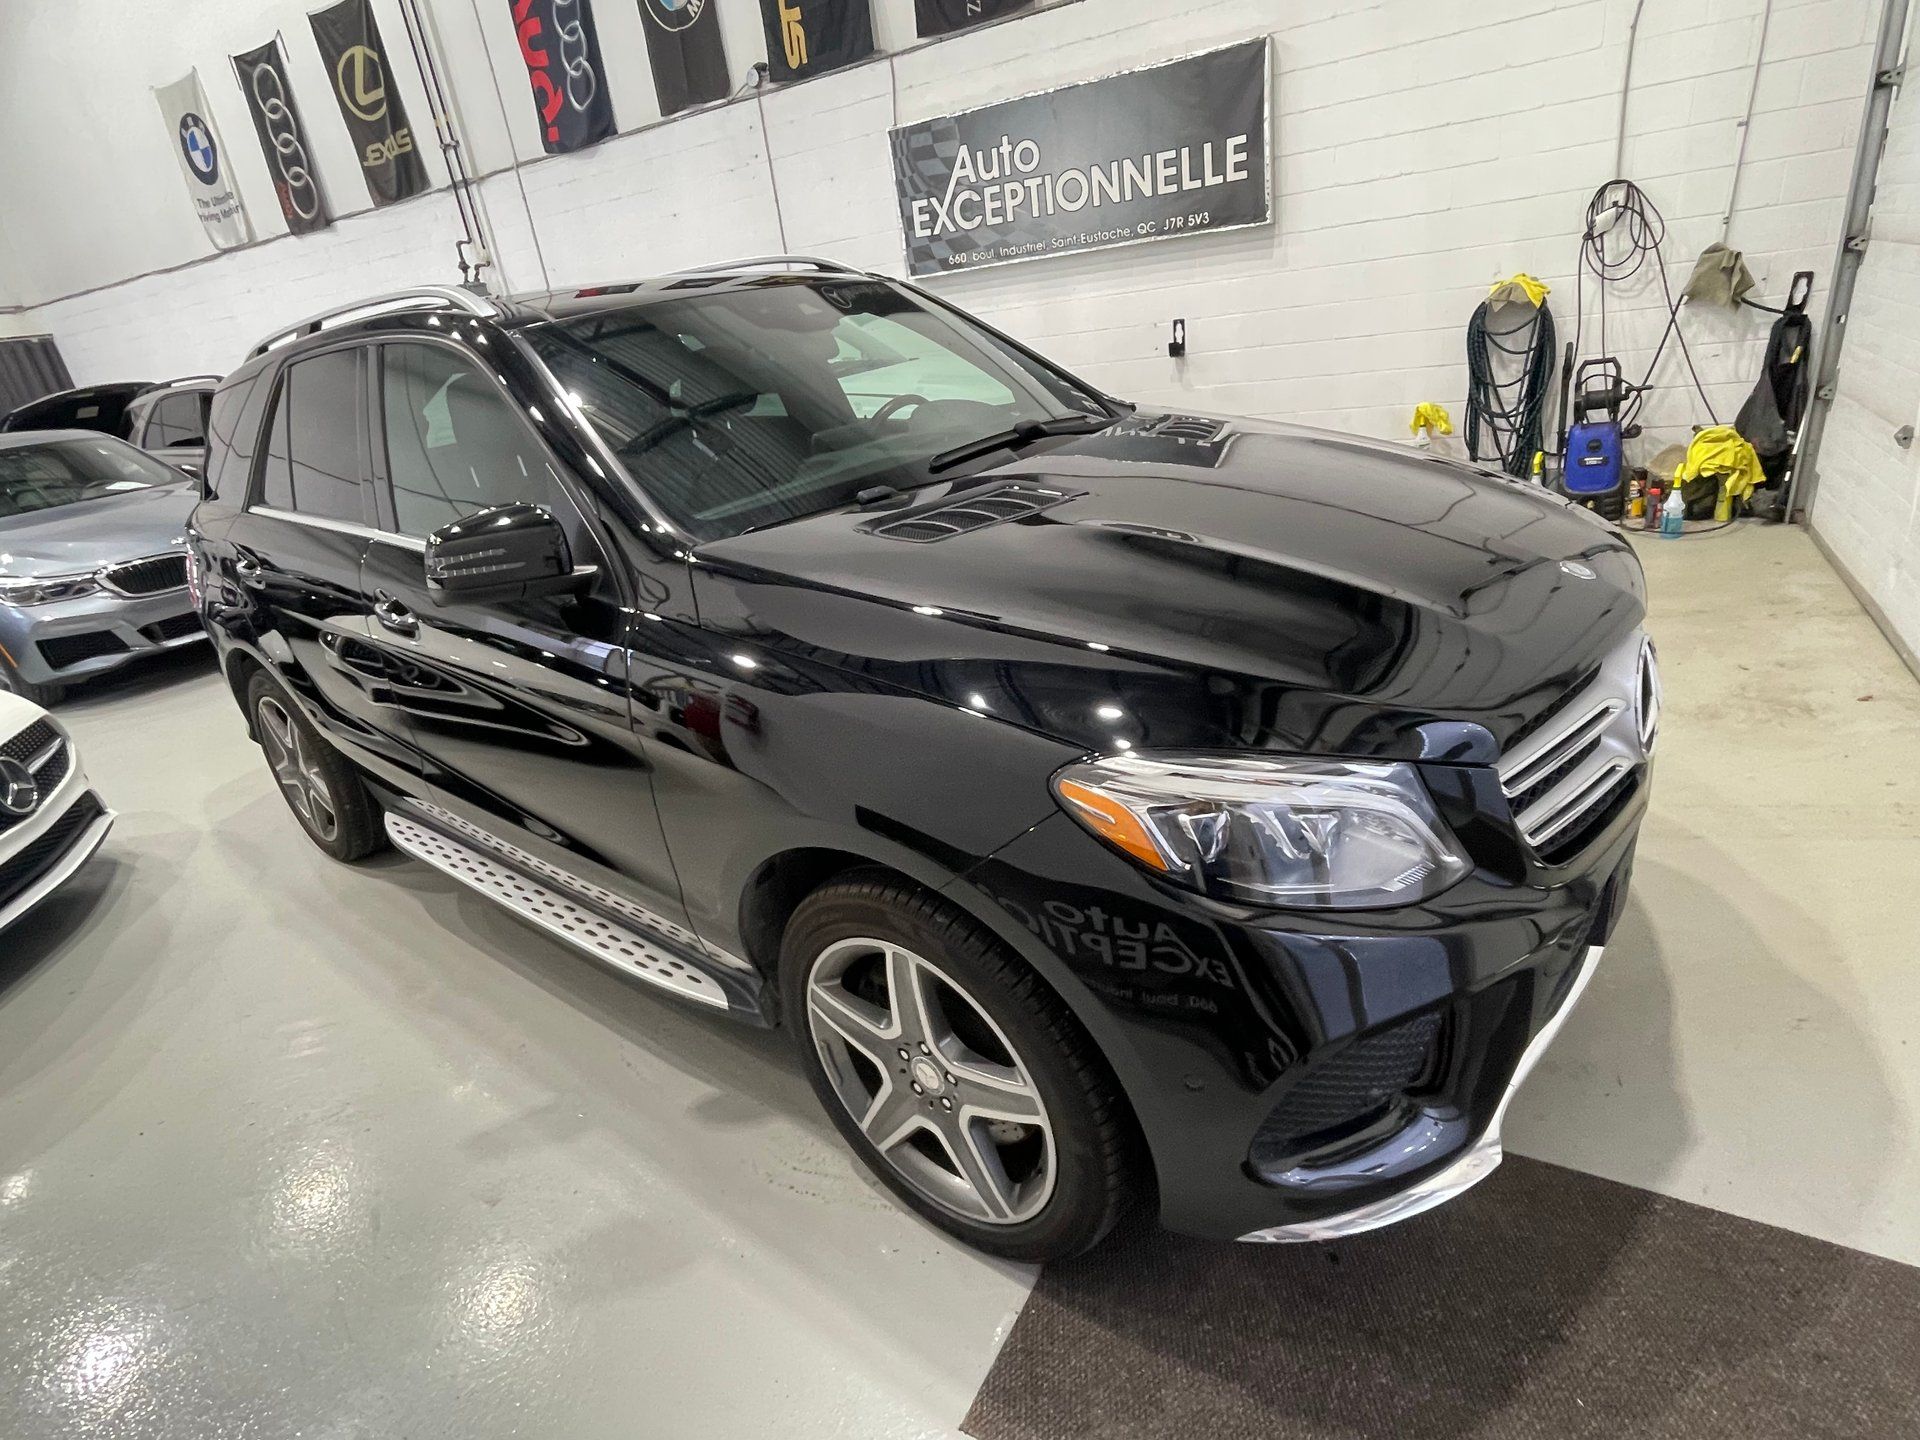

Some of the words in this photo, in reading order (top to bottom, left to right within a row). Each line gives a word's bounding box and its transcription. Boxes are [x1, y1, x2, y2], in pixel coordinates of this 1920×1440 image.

[363, 128, 412, 166] EXUS
[950, 134, 1040, 185] Auto
[911, 134, 1249, 238] EXCEPTIONNELLE
[1051, 226, 1134, 249] Saint-Eustache,
[1137, 221, 1156, 235] QC
[1163, 216, 1184, 231] J7R
[1188, 211, 1210, 227] 5V3
